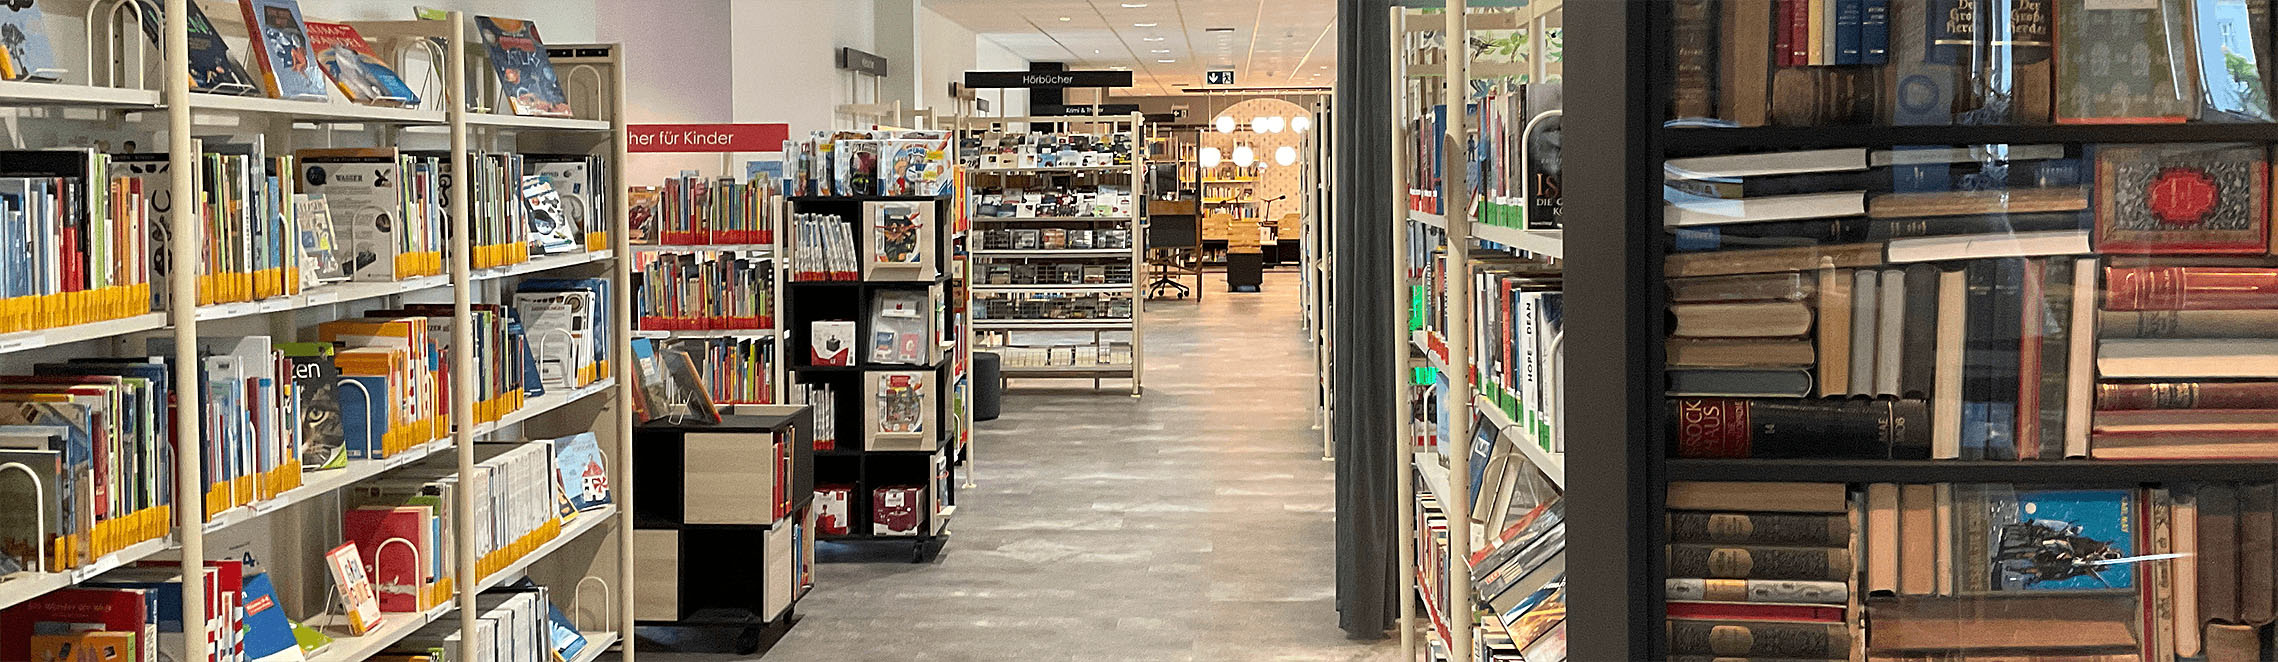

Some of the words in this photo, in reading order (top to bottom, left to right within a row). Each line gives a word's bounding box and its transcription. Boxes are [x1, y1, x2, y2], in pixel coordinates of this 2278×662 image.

[1022, 75, 1073, 85] Hörbücher
[658, 131, 680, 145] für
[683, 131, 734, 145] Kinder
